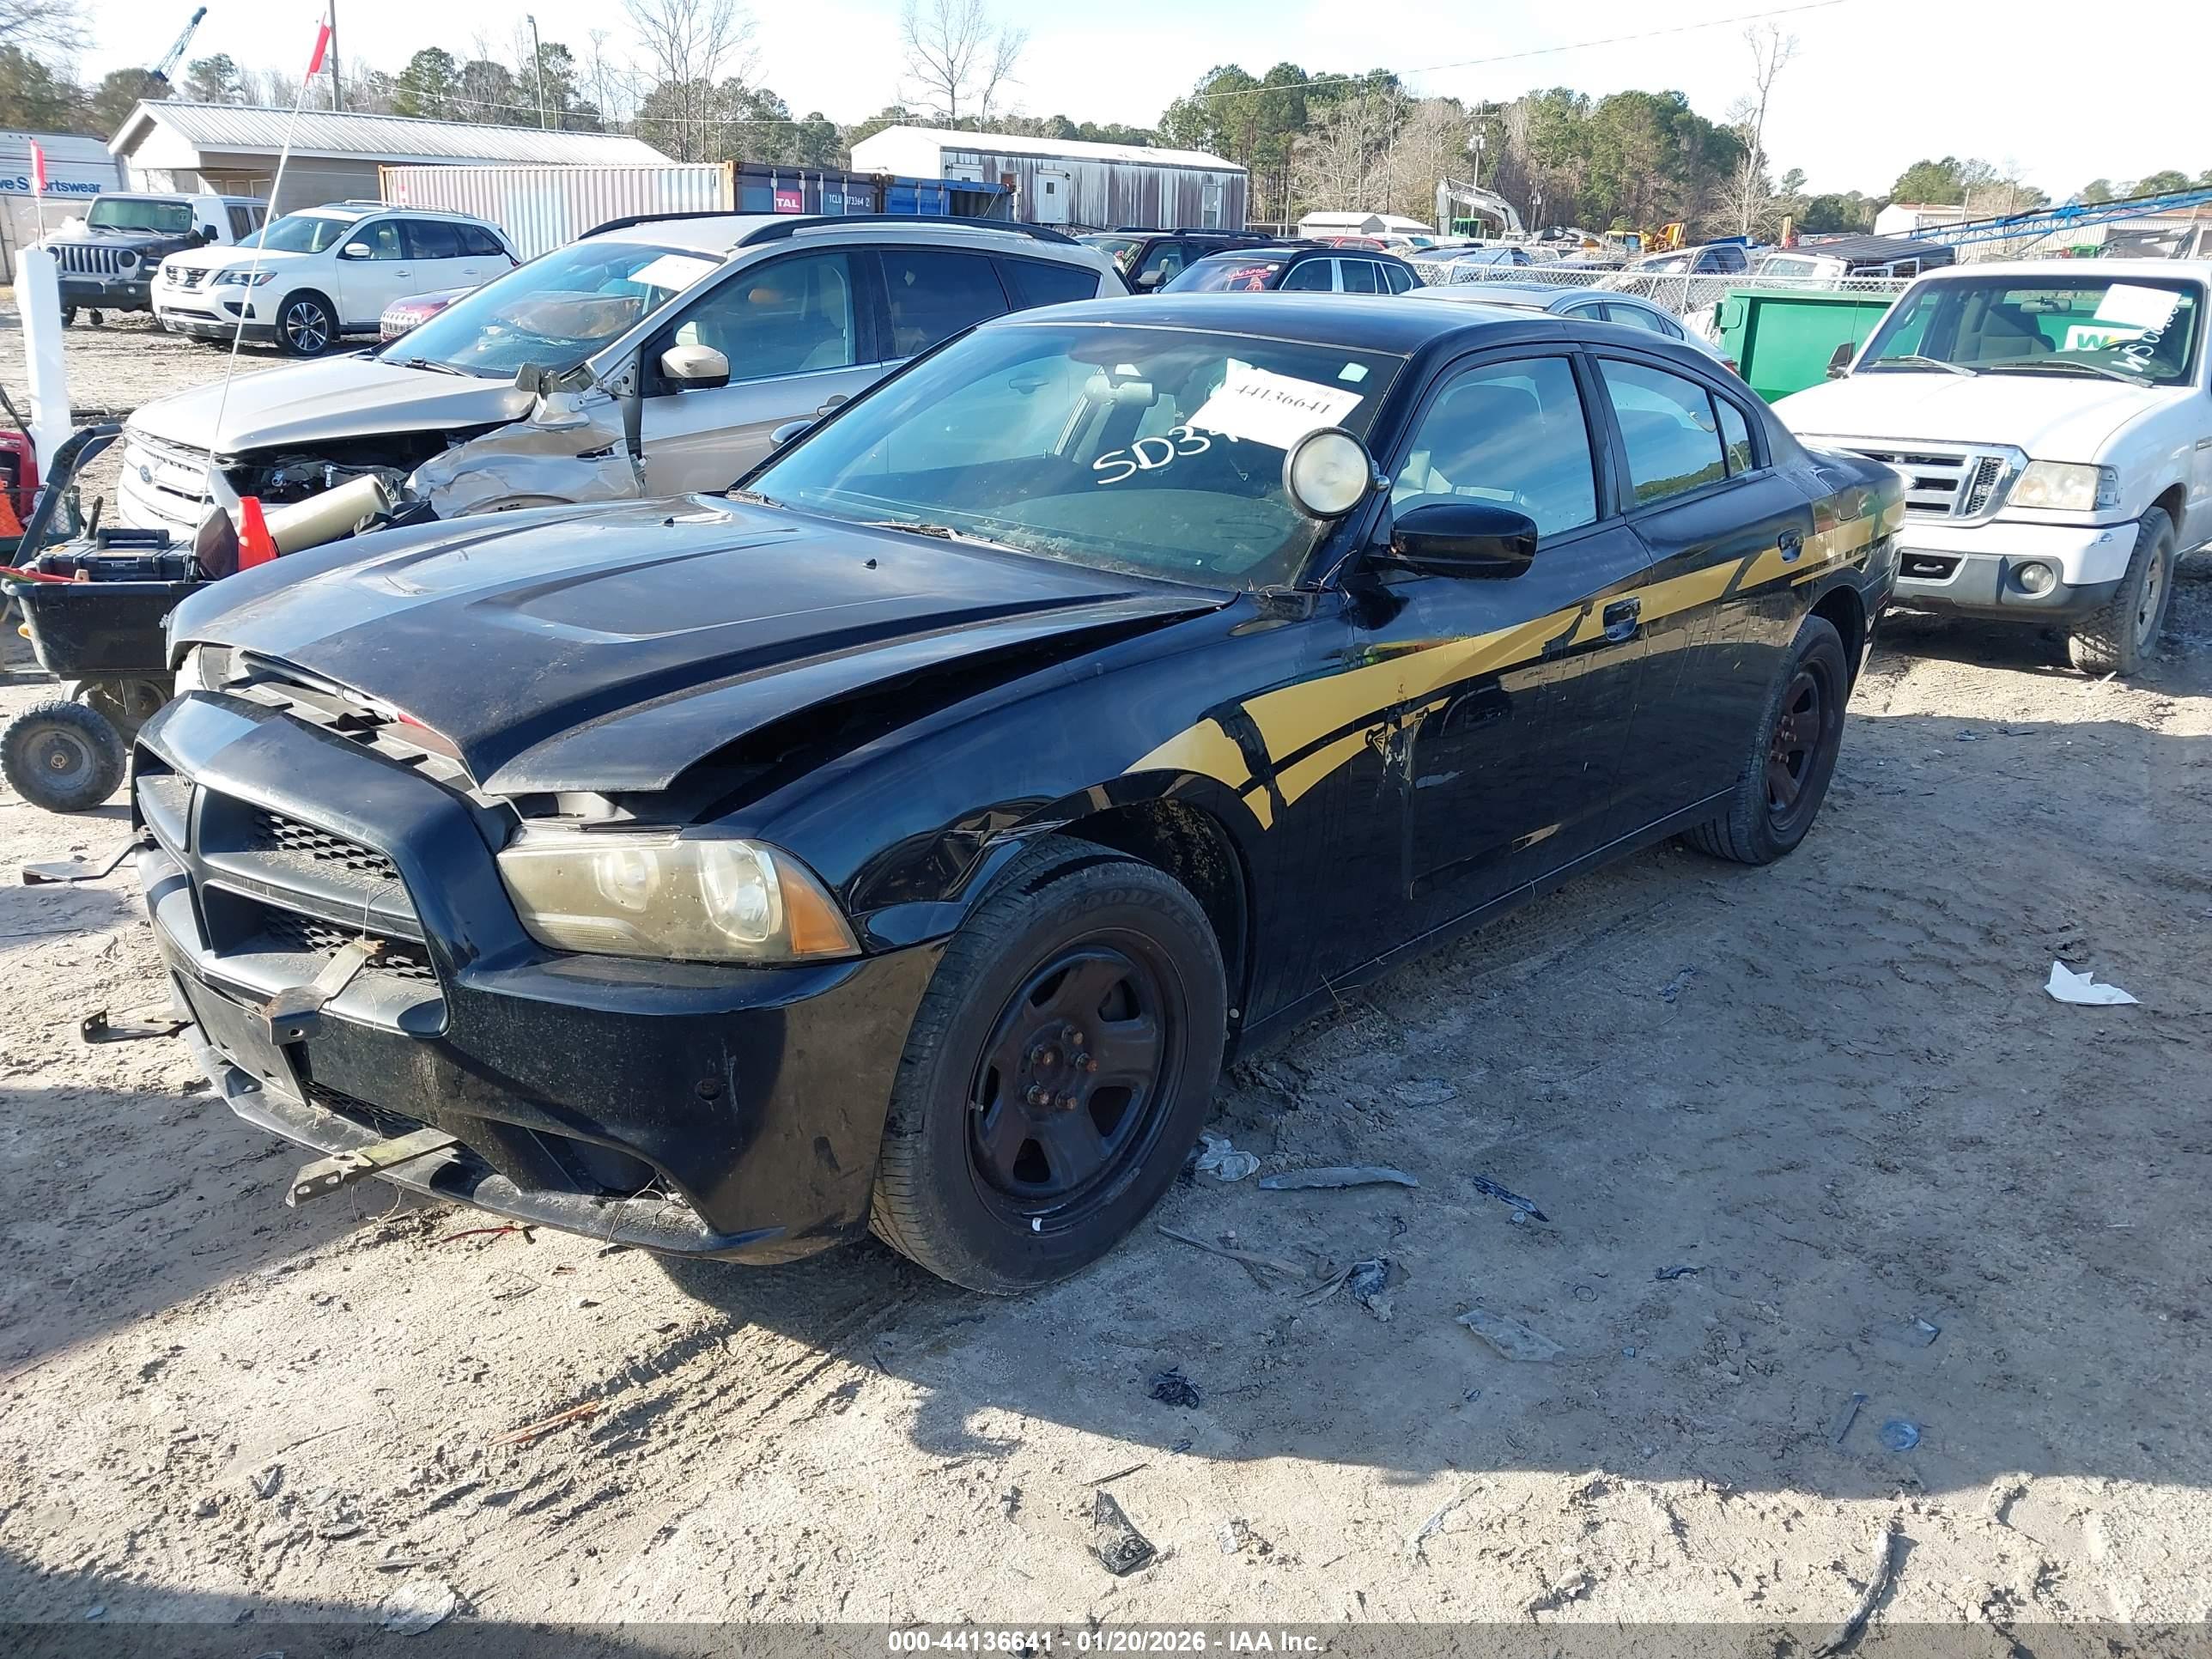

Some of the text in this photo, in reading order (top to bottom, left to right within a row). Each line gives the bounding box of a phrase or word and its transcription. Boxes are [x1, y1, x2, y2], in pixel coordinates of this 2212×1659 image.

[17, 176, 101, 193] Sortswear
[776, 198, 799, 209] TAL
[1235, 385, 1331, 415] 44136641
